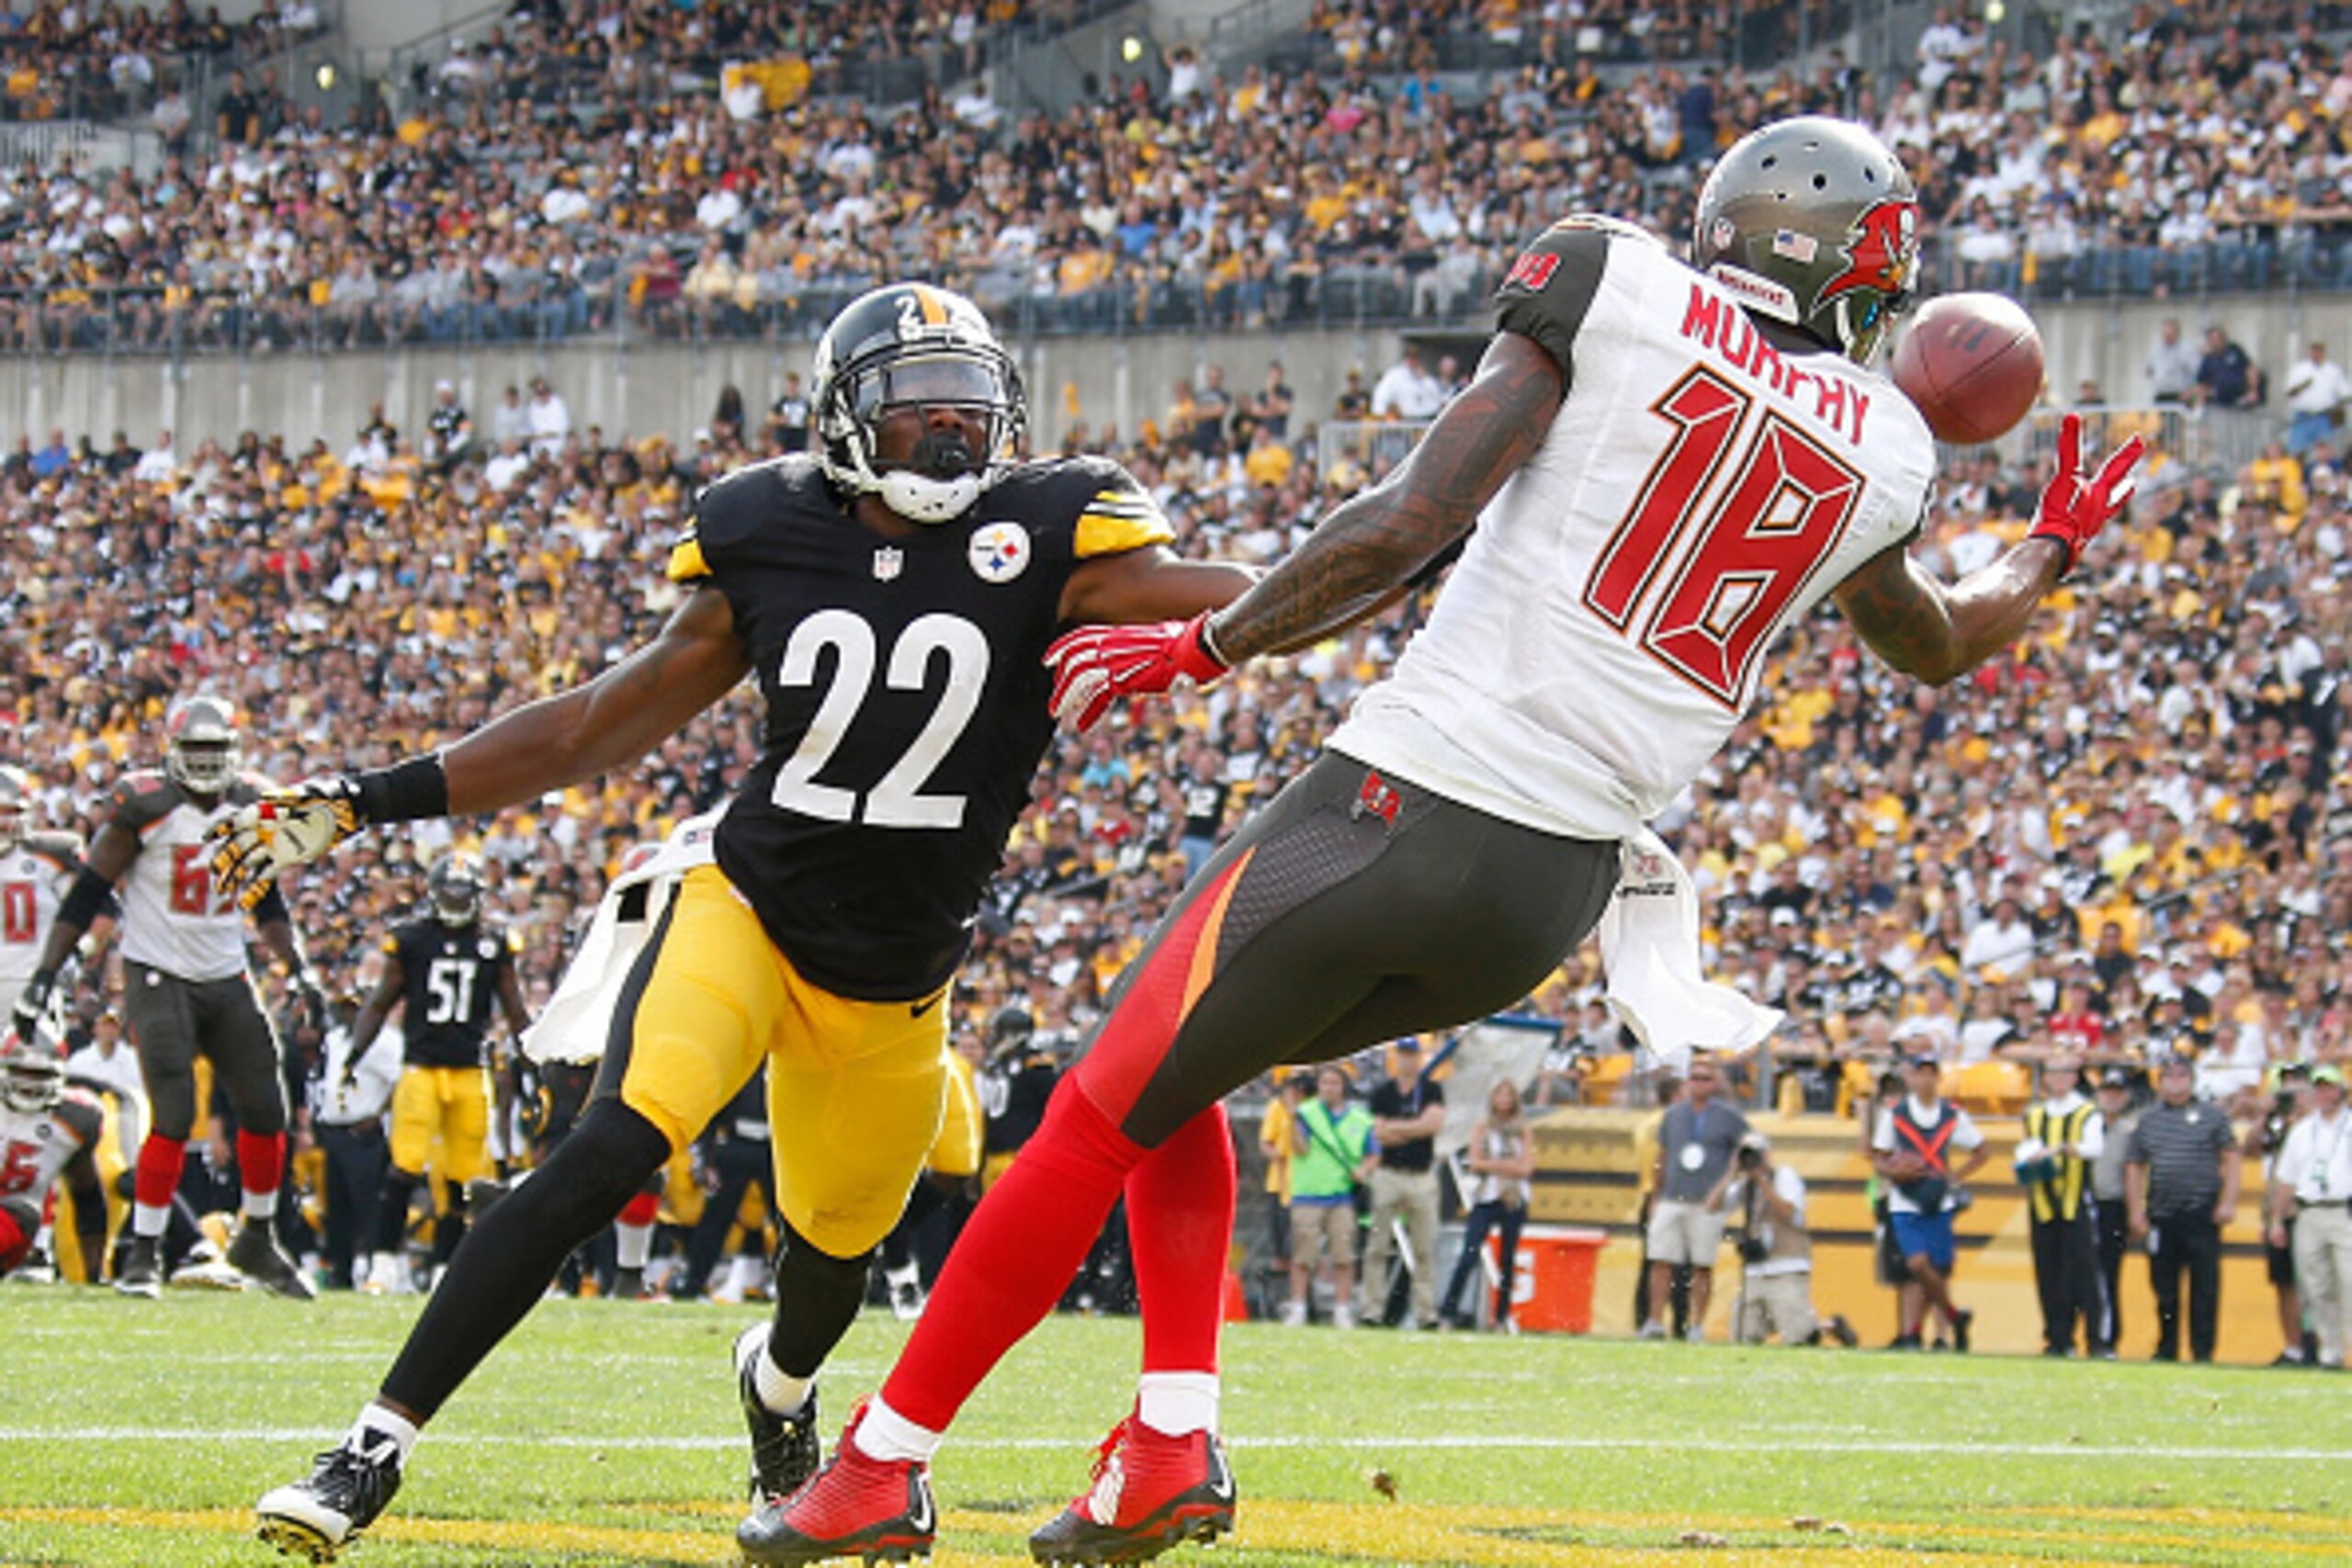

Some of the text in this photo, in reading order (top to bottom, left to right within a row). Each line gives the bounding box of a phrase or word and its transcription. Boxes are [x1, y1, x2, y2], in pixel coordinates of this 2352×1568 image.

[1680, 282, 1870, 446] MURPHY
[1581, 361, 1866, 713] 18
[772, 609, 990, 828] 22
[169, 843, 237, 917] 6
[427, 958, 477, 1022] 51
